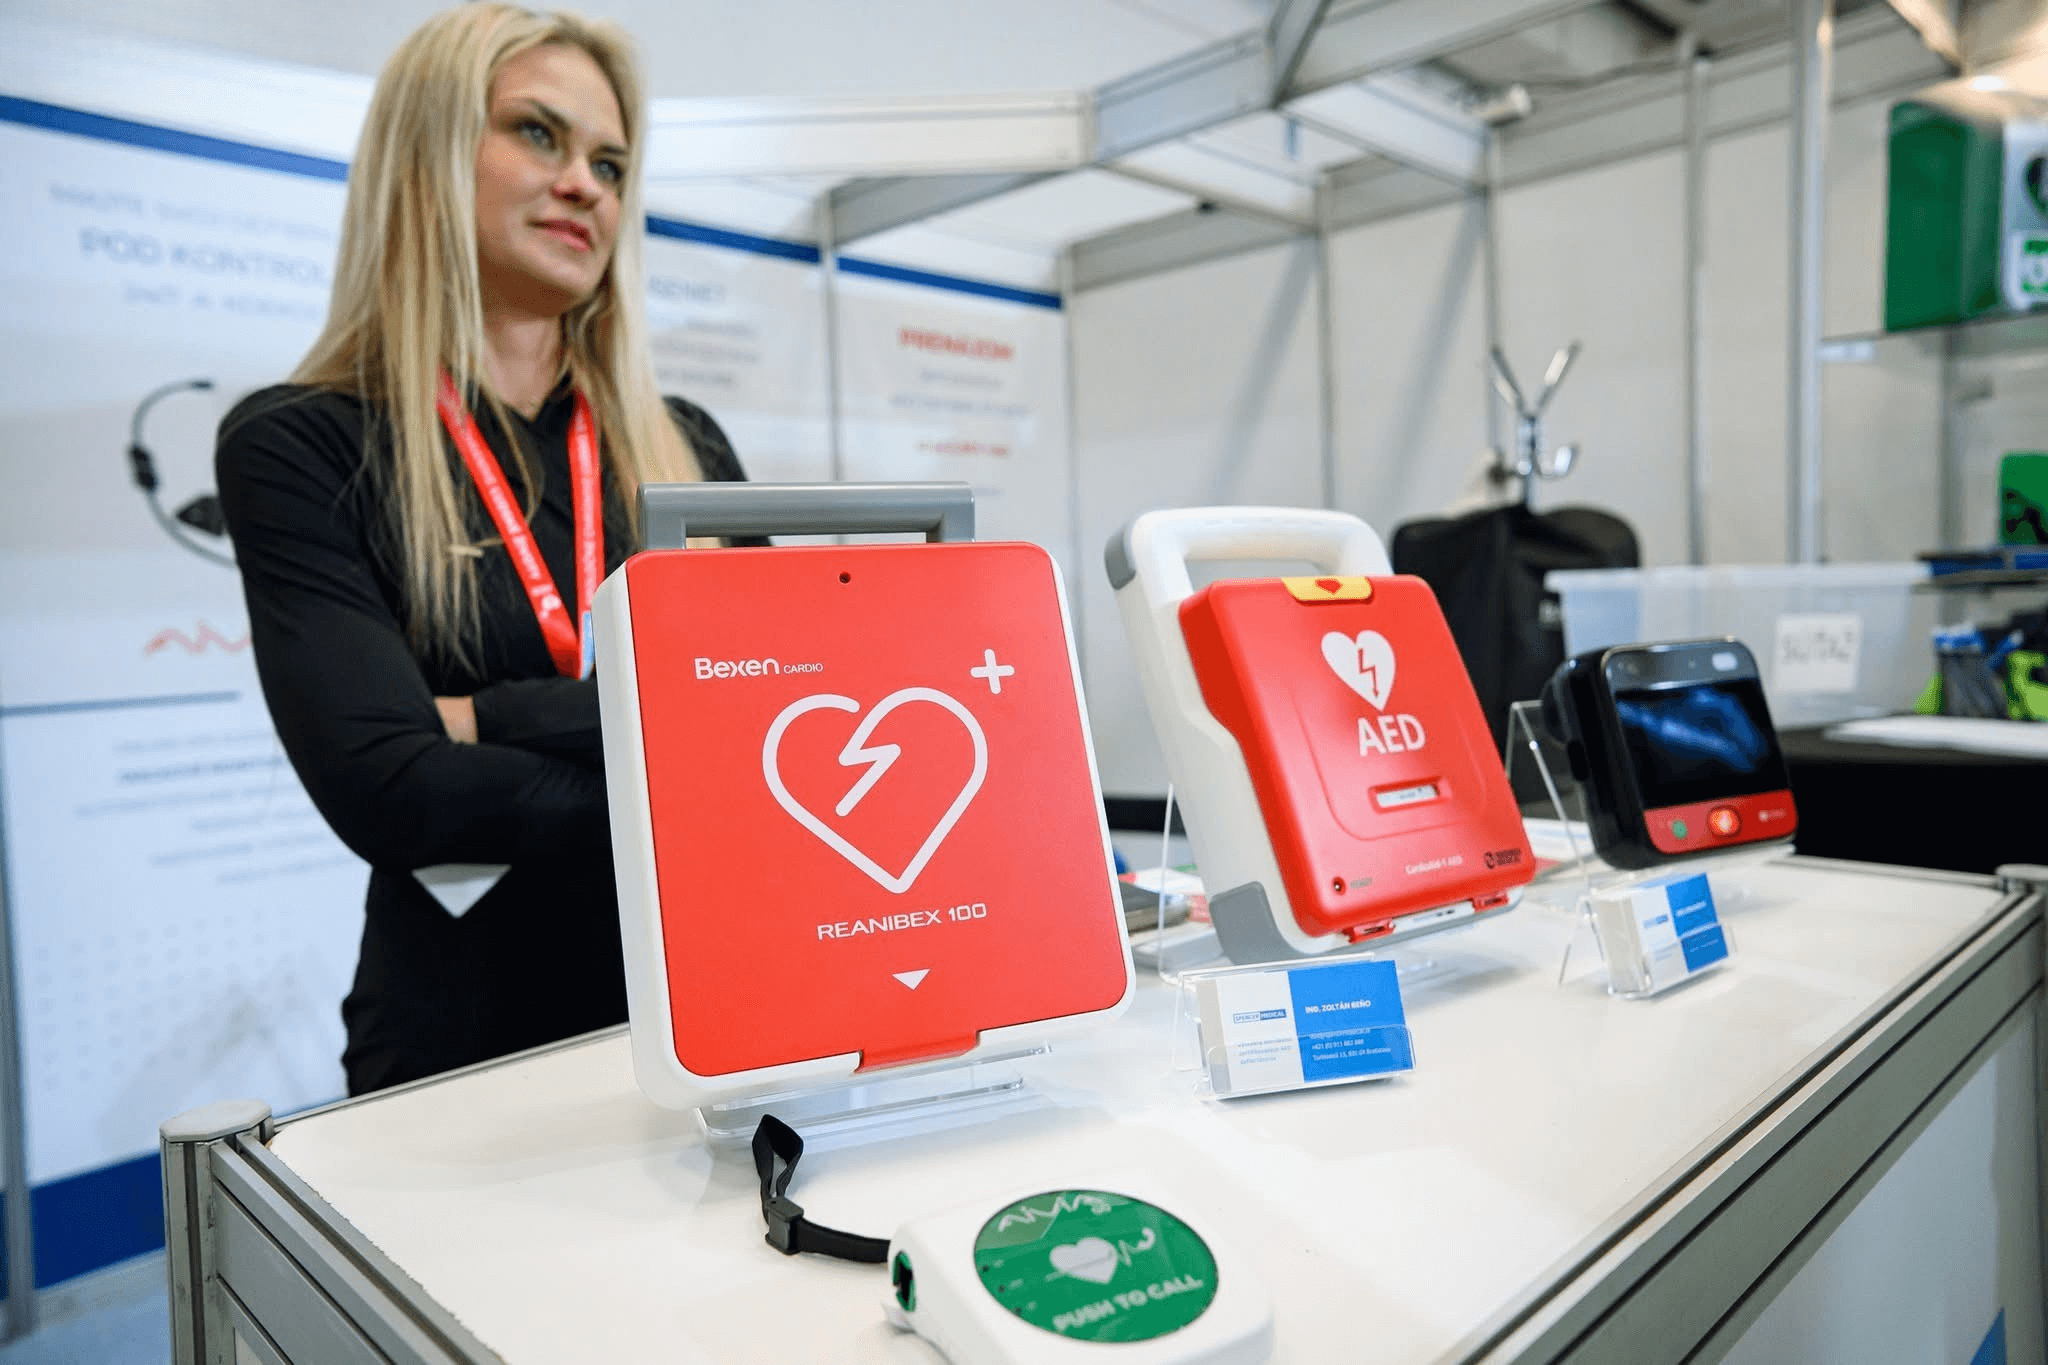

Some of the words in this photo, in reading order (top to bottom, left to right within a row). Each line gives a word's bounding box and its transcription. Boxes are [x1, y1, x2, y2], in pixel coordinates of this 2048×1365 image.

[694, 657, 780, 680] Bexen
[783, 662, 824, 675] CARDIO
[1356, 713, 1426, 757] AED
[816, 909, 943, 941] REANIBEX
[947, 902, 988, 923] 100
[1053, 1299, 1115, 1332] PUSH
[1112, 1288, 1148, 1311] TO
[1146, 1273, 1204, 1301] CALL
